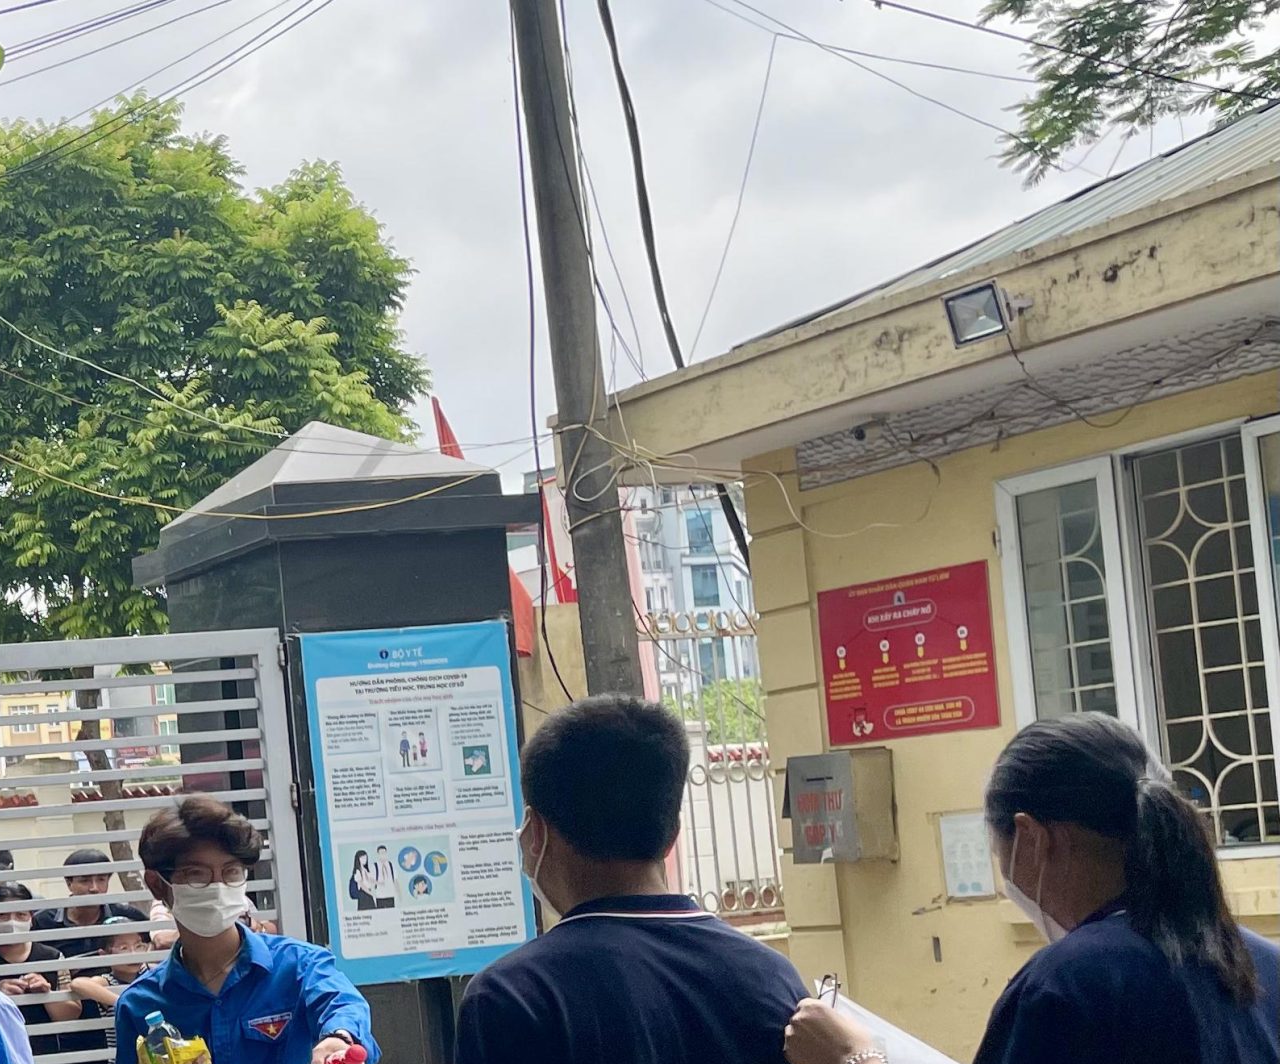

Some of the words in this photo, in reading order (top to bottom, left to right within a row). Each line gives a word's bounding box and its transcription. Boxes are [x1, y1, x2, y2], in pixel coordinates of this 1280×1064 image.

[392, 648, 404, 659] BỘ
[405, 649, 411, 657] Y
[413, 646, 423, 657] TẾ
